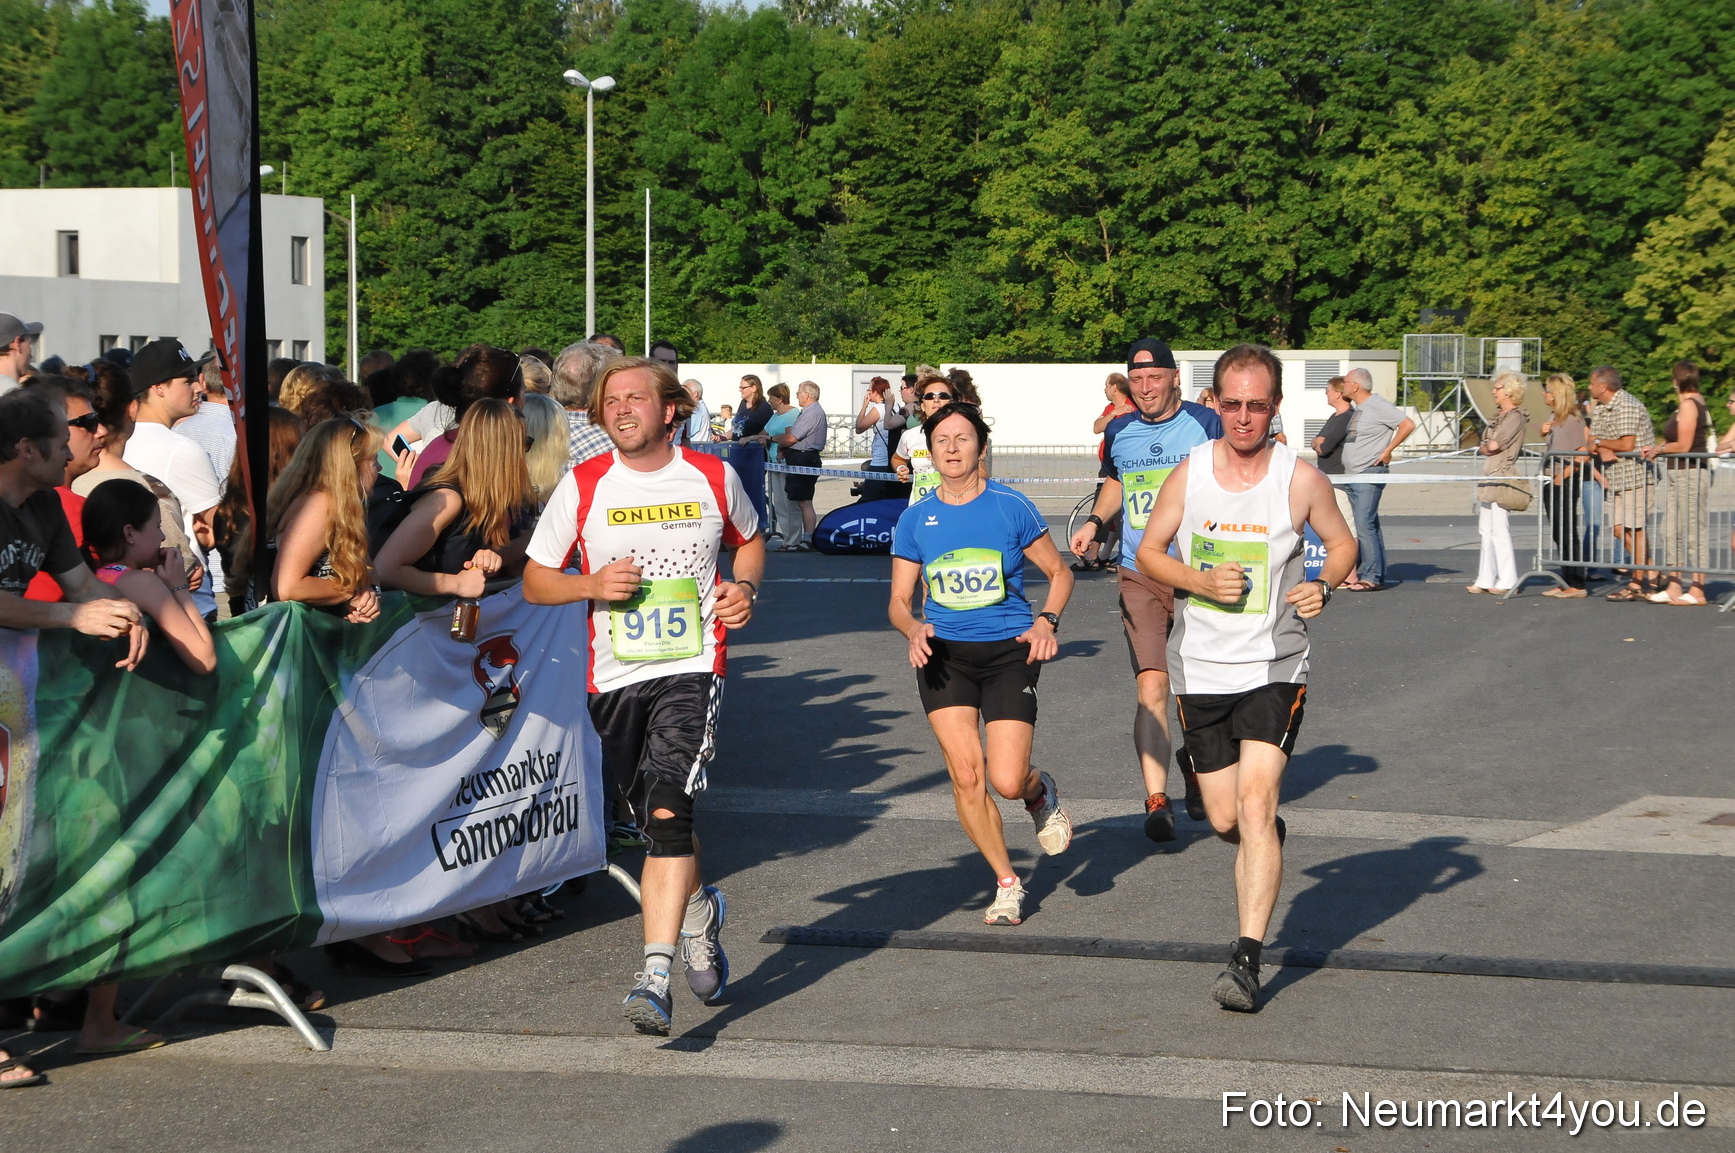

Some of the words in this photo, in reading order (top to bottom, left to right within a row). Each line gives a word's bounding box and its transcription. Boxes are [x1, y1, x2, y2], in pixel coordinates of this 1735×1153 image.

[1121, 453, 1190, 469] SCHABMÜLLE
[612, 504, 694, 523] ONLINE
[661, 520, 702, 531] Germany
[931, 566, 1000, 594] 1362
[623, 607, 687, 641] 915
[431, 785, 578, 872] Lammsbräu
